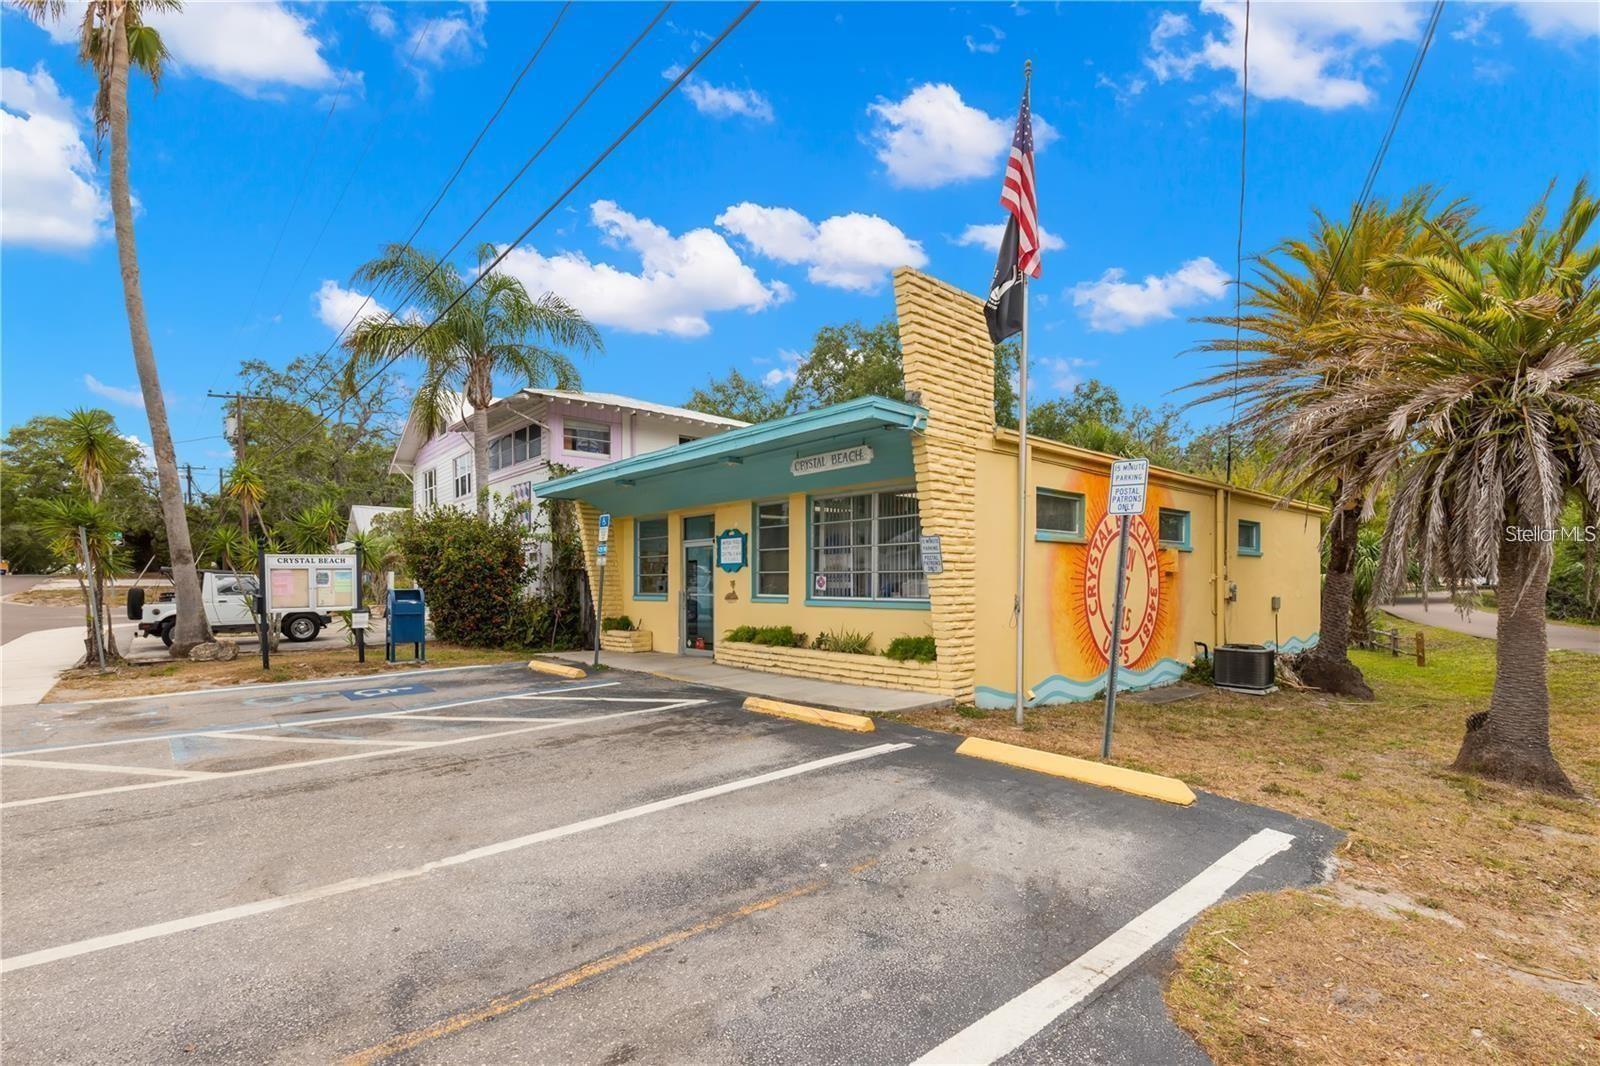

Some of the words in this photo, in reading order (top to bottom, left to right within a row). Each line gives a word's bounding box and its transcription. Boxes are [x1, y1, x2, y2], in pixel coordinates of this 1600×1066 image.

[794, 456, 825, 472] CRYSTAL
[831, 448, 864, 465] BEACH
[1123, 463, 1146, 471] MINUTE
[1112, 495, 1142, 504] PATRONS
[1115, 487, 1140, 496] POSTAL
[1117, 503, 1135, 511] ONLY
[1115, 514, 1150, 548] BACH
[1087, 519, 1113, 617] CRYSTAL
[1147, 550, 1157, 578] FL
[1138, 587, 1158, 649] 34681
